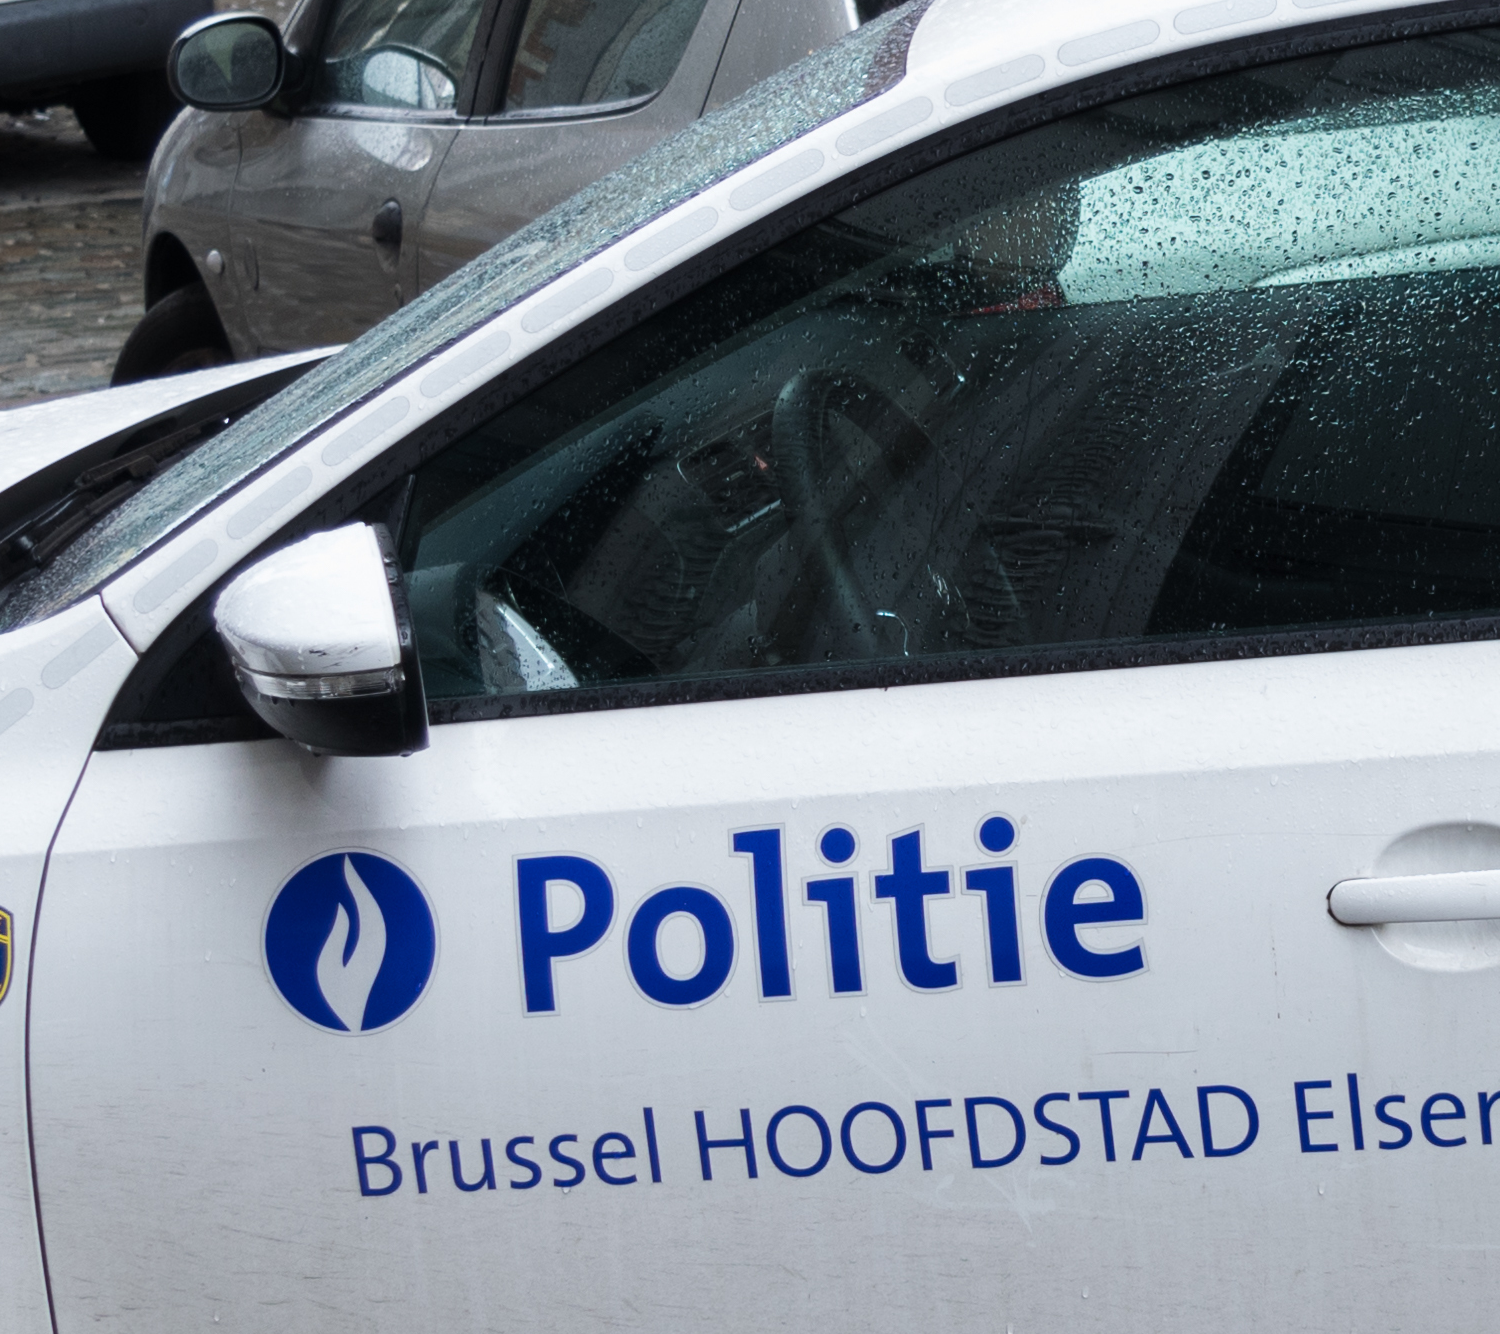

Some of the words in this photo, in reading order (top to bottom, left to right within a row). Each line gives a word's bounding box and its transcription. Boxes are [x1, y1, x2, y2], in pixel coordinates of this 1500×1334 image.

[516, 816, 1145, 1013] Politie
[351, 1106, 662, 1197] Brussel
[693, 1084, 1260, 1181] HOOFDSTAD
